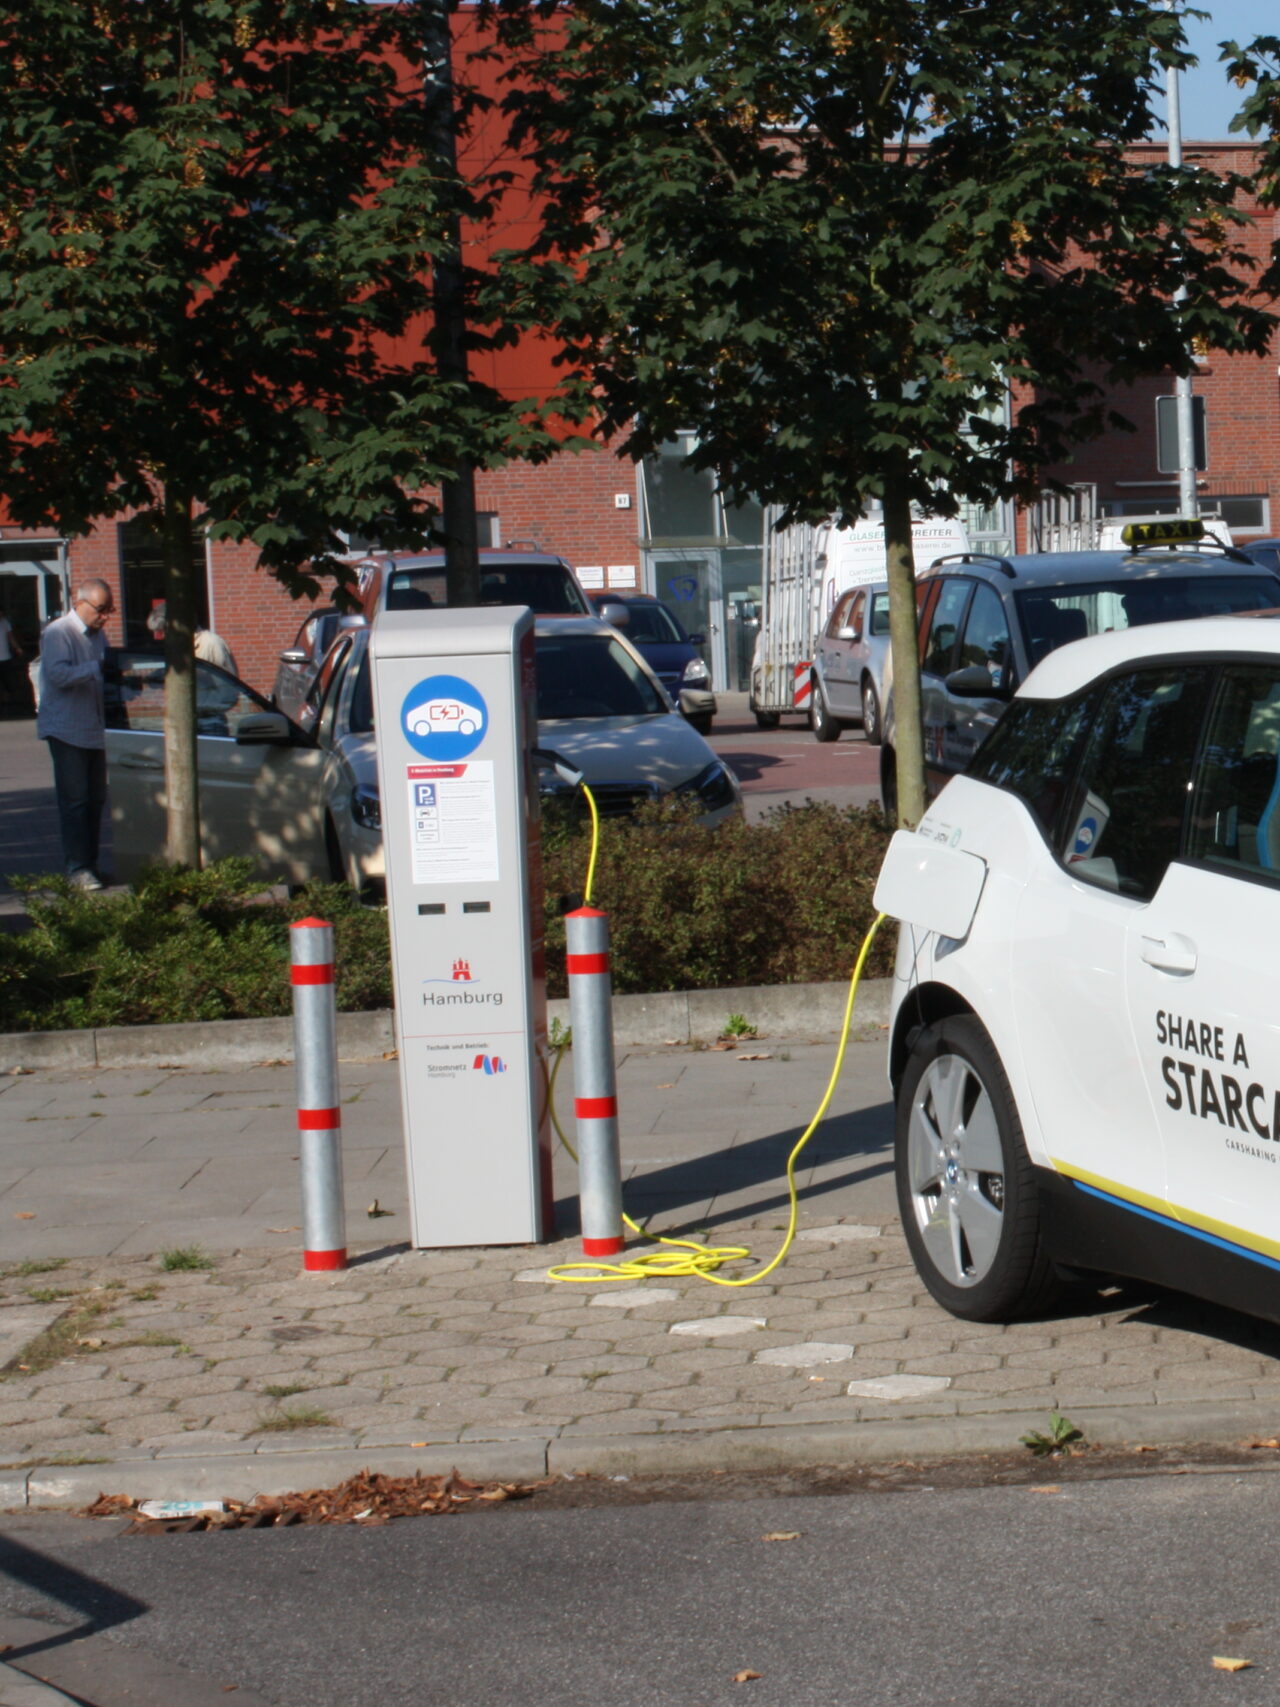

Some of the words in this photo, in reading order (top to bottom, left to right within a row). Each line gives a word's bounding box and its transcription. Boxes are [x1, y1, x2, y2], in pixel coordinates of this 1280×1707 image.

[1138, 522, 1194, 539] TAXI
[418, 786, 432, 804] P
[423, 991, 503, 1006] Hamburg
[1156, 1009, 1224, 1062] SHARE
[1233, 1032, 1249, 1069] A
[427, 1063, 467, 1072] Stromnetz
[1225, 1138, 1276, 1164] CARSHARING
